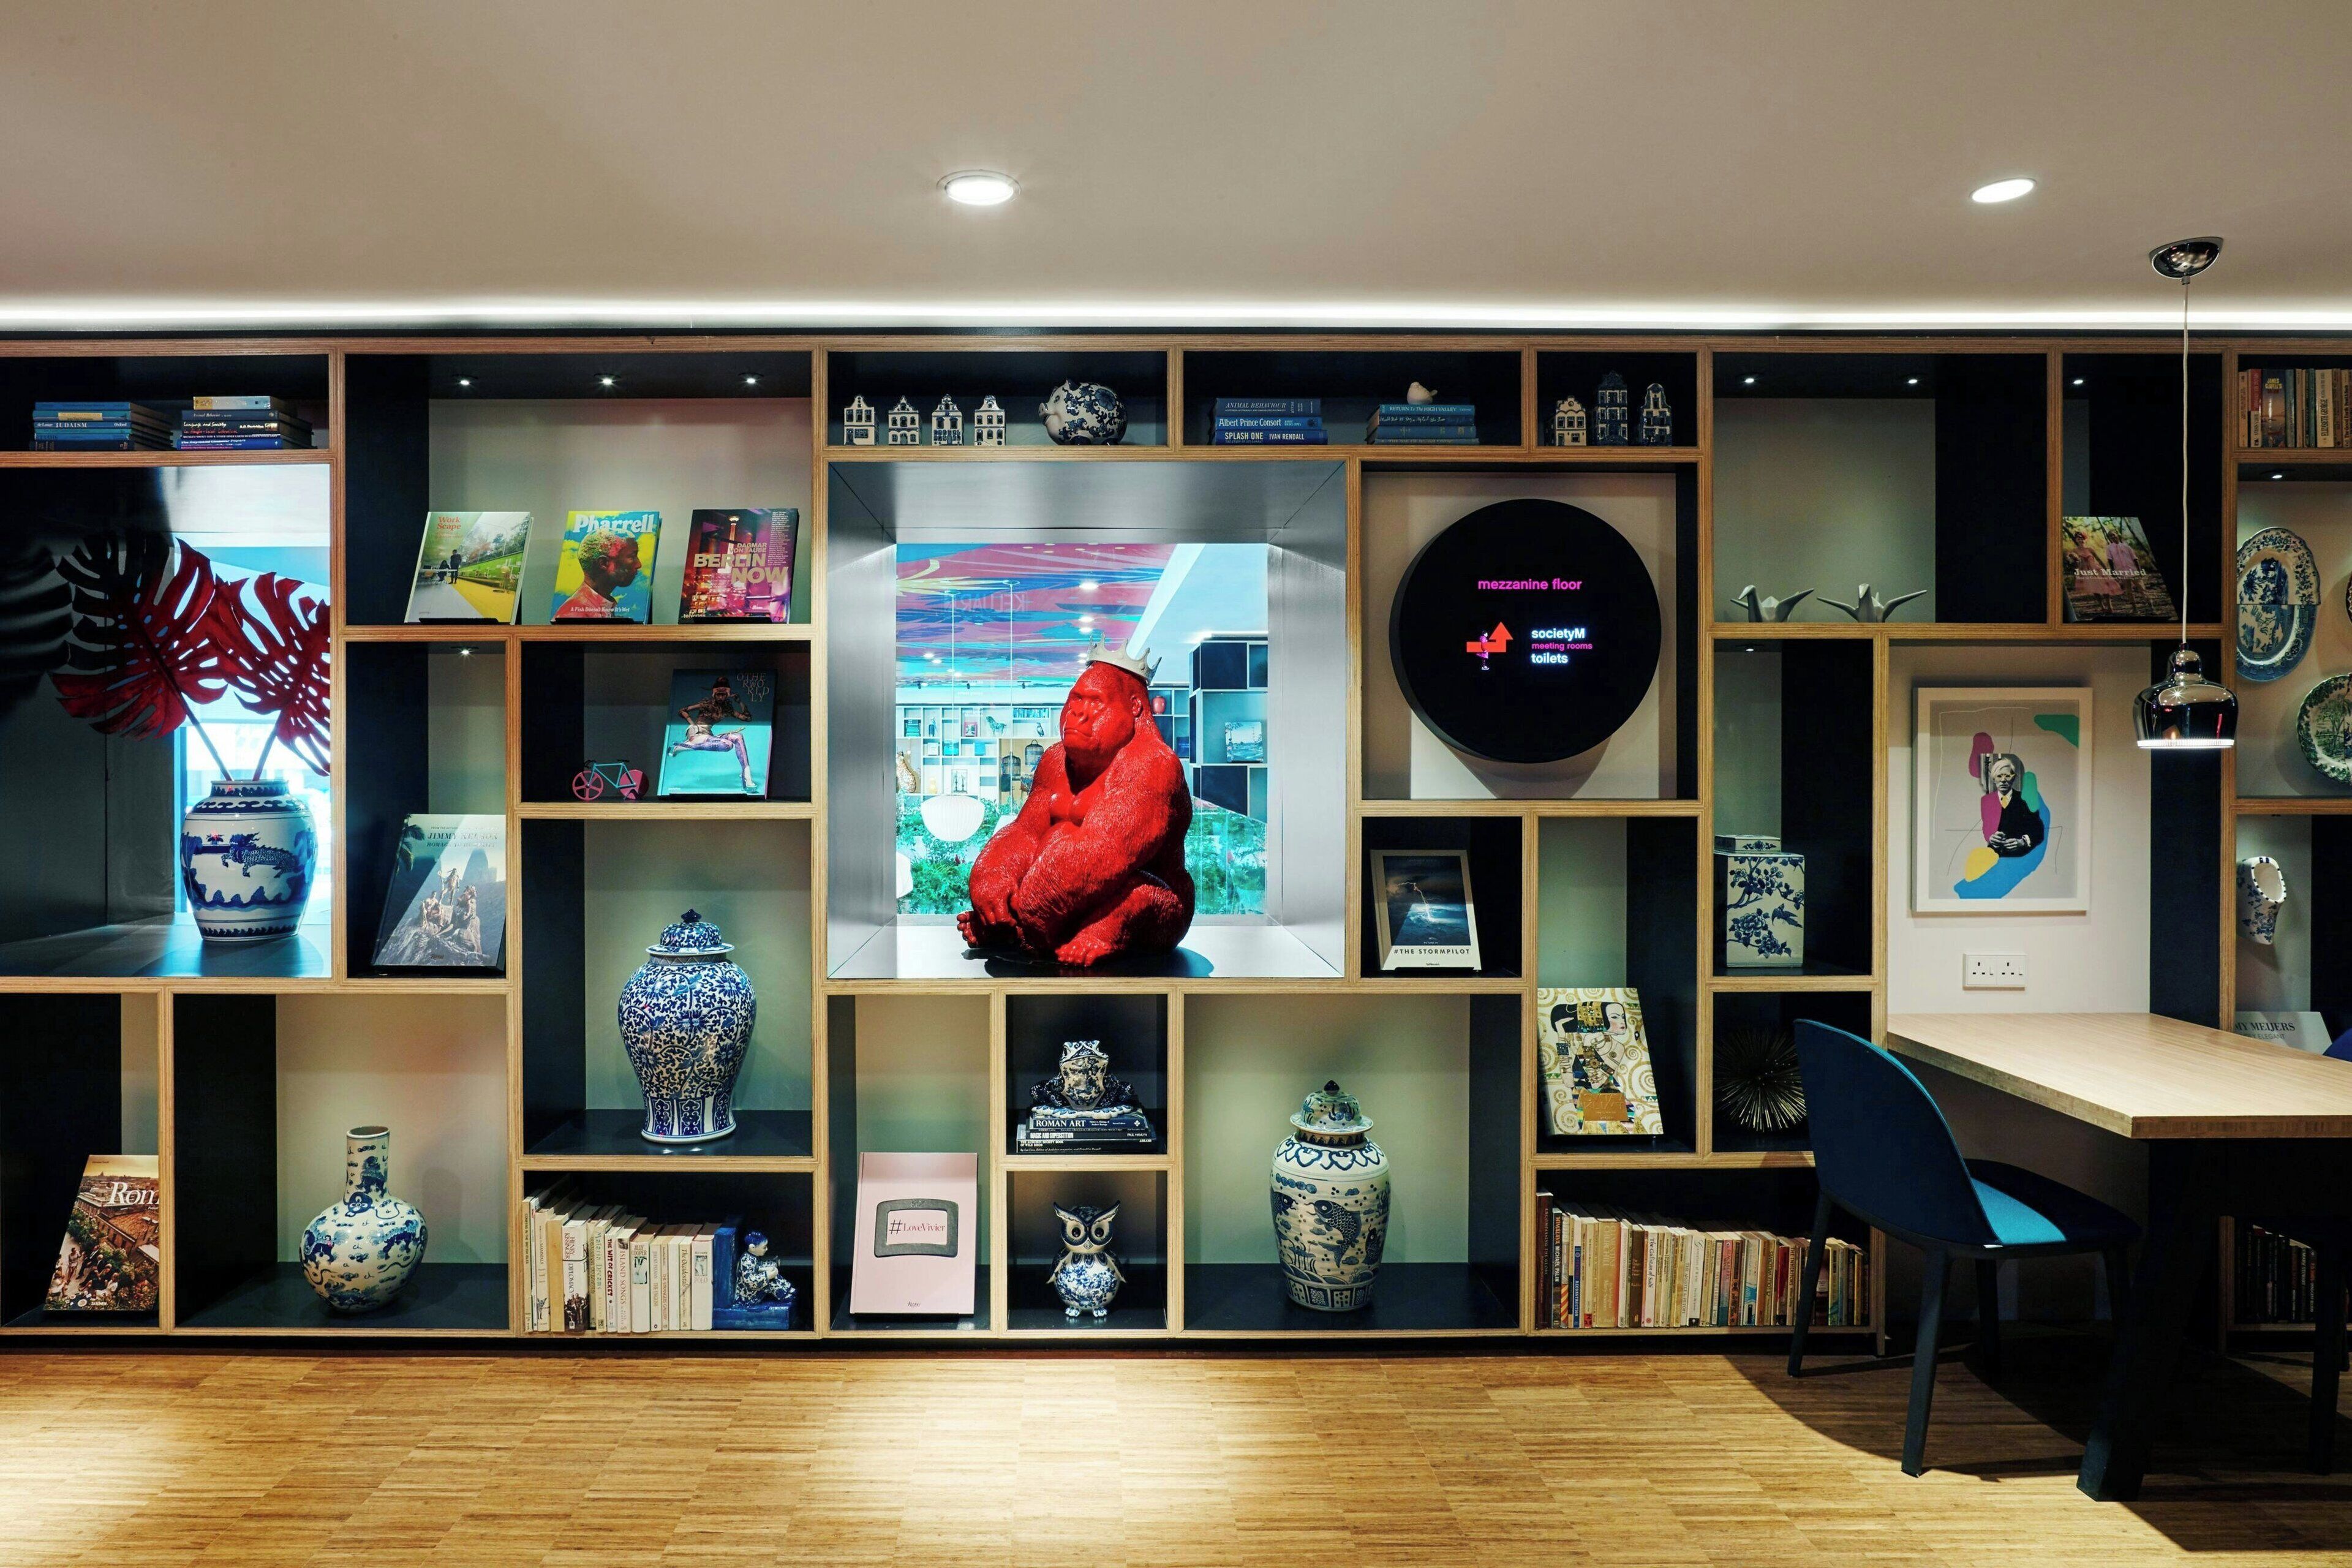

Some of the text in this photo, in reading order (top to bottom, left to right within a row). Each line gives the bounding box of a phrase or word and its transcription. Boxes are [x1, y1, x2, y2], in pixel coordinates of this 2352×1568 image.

[1219, 418, 1238, 427] Albert
[573, 514, 655, 533] Pharrell
[693, 553, 766, 568] BERLIN
[731, 567, 789, 584] NOW
[1478, 578, 1582, 590] mezzanine floor
[1531, 628, 1585, 641] societyM
[1531, 643, 1565, 651] meeting
[1531, 652, 1568, 663] toilets
[2250, 1022, 2296, 1031] MEIJERS
[107, 1182, 159, 1205] Rom
[889, 1219, 946, 1235] #LoveVivier
